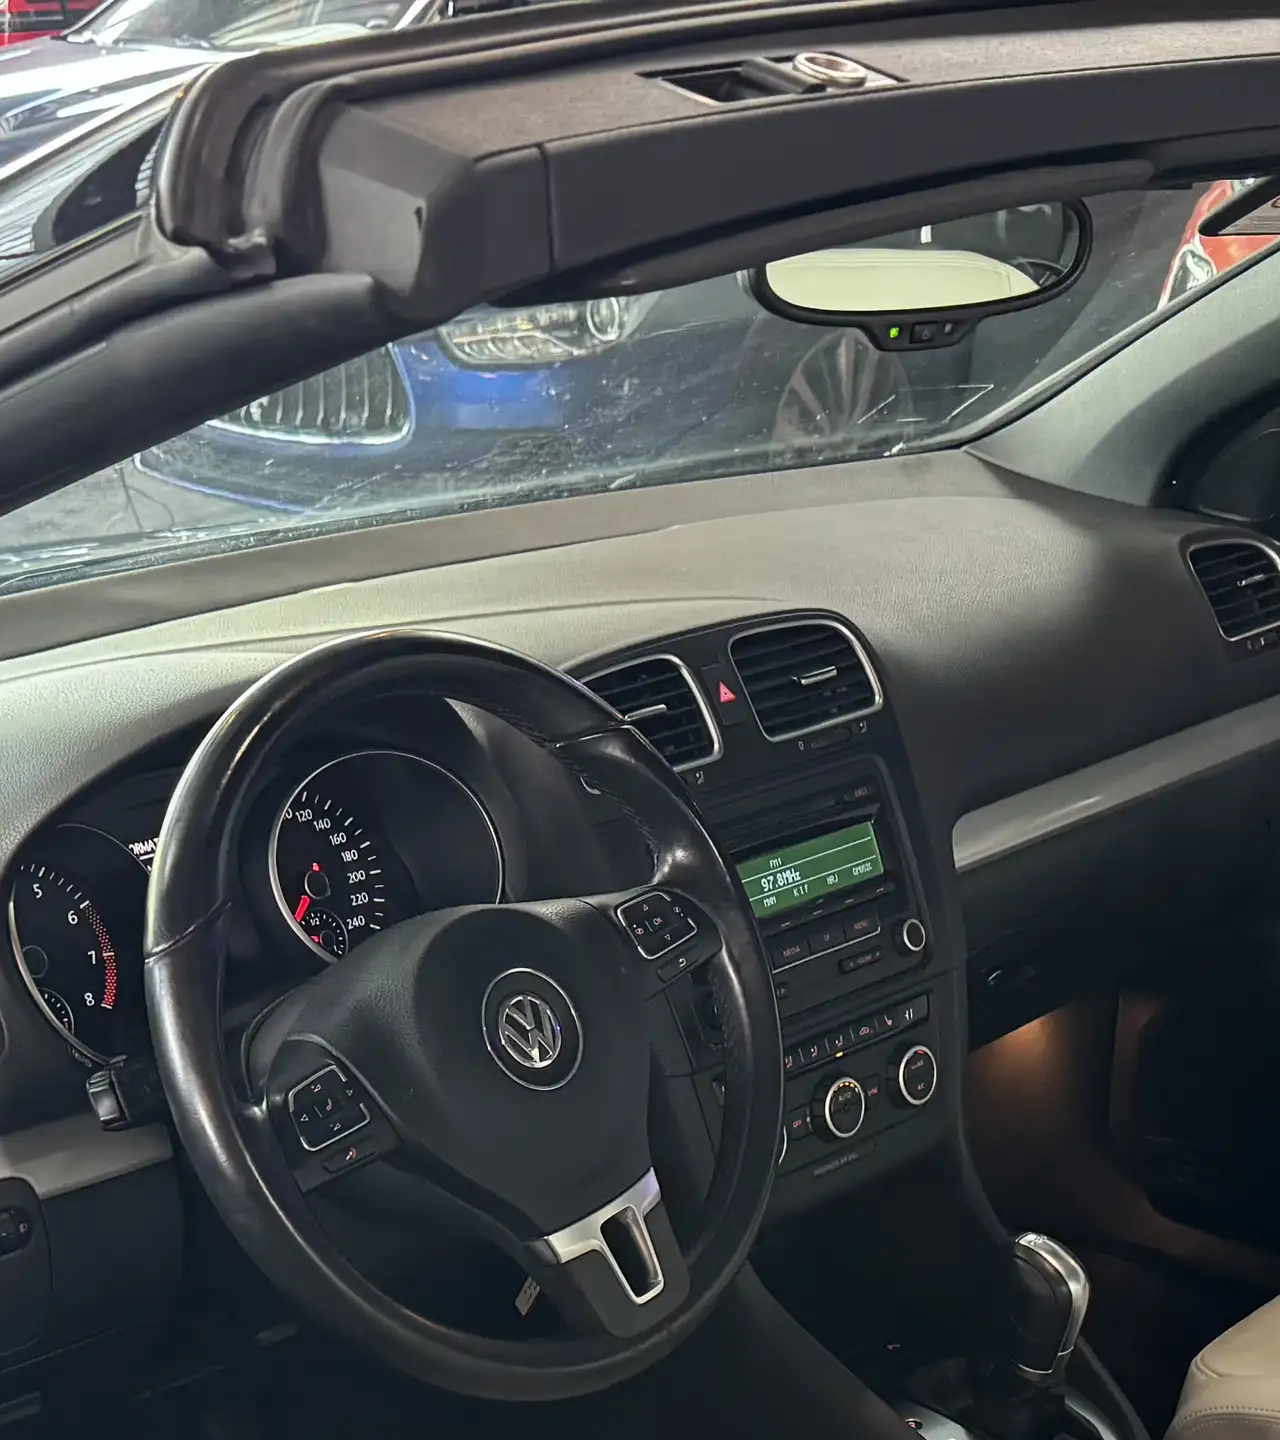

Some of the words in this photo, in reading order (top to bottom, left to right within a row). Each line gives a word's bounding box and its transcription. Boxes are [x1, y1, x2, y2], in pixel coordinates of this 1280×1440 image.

[295, 808, 313, 823] 120
[313, 818, 331, 831] 140
[329, 832, 347, 846] 160
[341, 849, 358, 863] 180
[347, 870, 366, 884] 200
[761, 868, 801, 892] 97.8MHz
[33, 882, 43, 899] 5
[350, 892, 369, 906] 220
[67, 910, 78, 925] 6
[310, 917, 320, 926] 1/2
[346, 915, 366, 930] 240
[88, 951, 97, 965] 7
[84, 992, 95, 1007] 8
